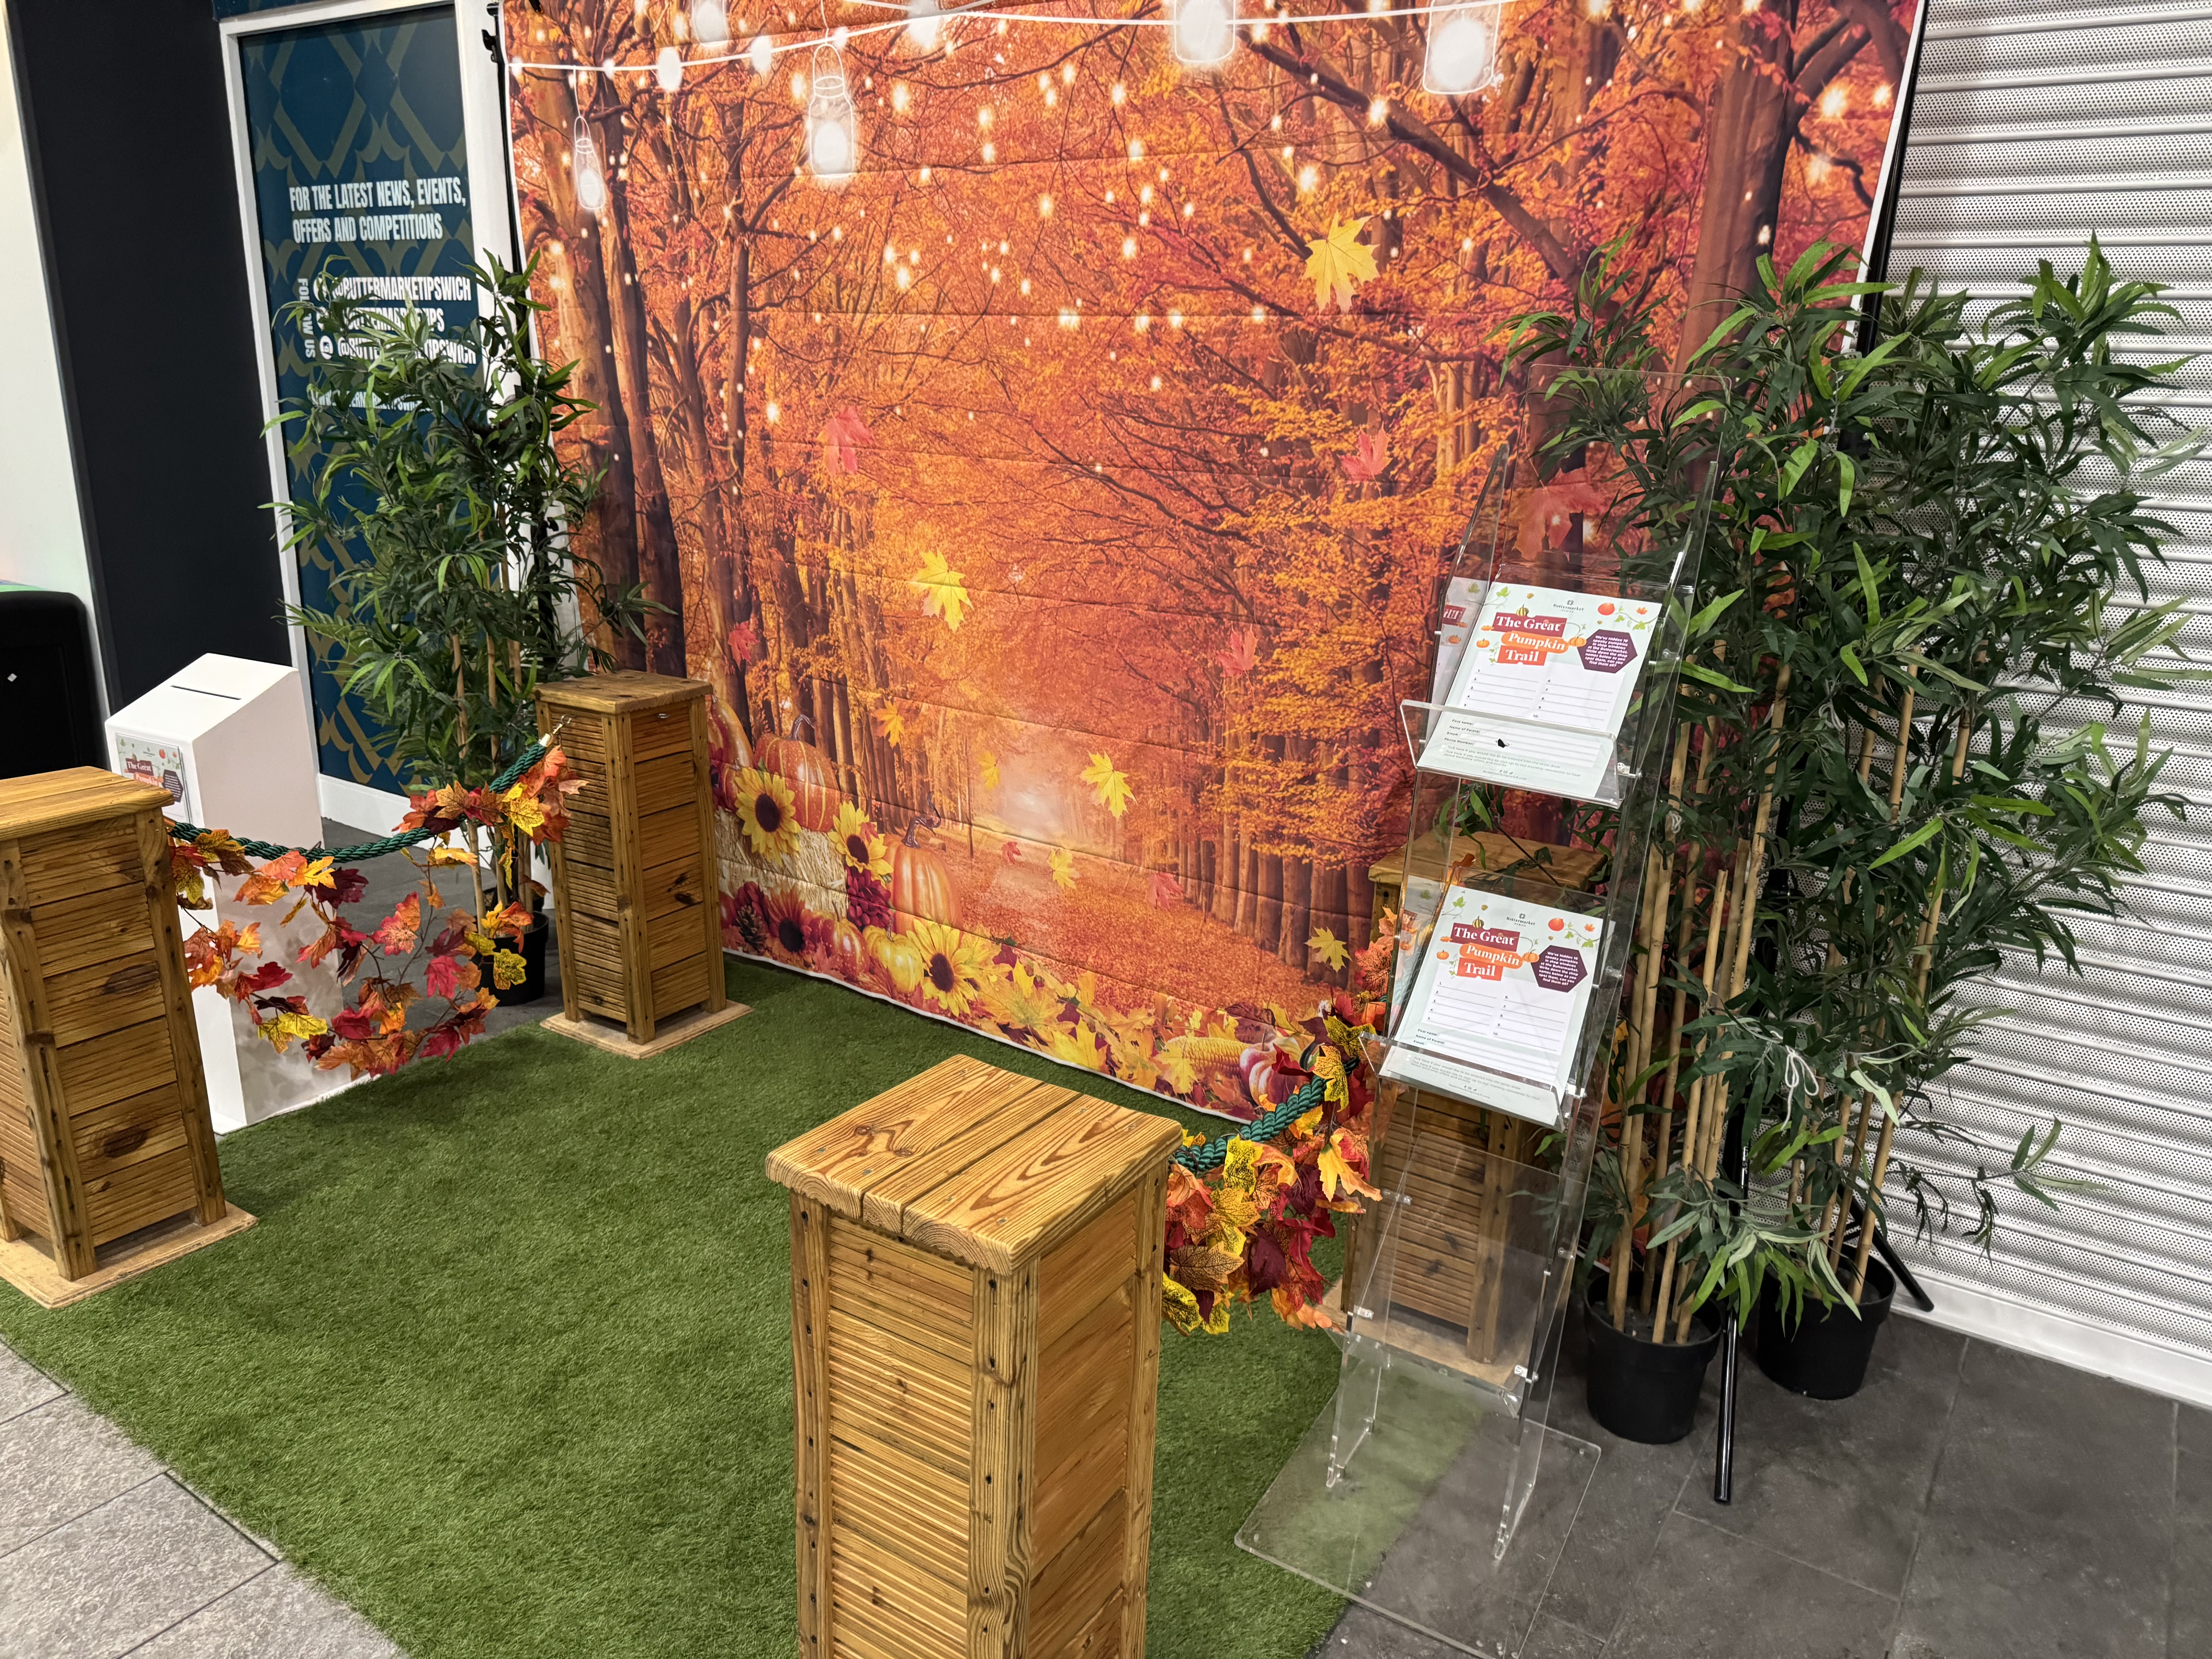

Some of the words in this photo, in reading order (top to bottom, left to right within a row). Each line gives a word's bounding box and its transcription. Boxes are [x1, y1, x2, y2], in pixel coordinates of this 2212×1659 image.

[289, 187, 310, 211] FOR
[311, 185, 333, 210] THE
[335, 182, 373, 209] LATEST
[376, 180, 414, 208] NEWS,
[416, 177, 466, 206] EVENTS,
[293, 218, 332, 243] OFFERS
[334, 216, 357, 242] AND
[359, 213, 443, 240] COMPETITIONS
[298, 278, 313, 335] FOLW
[304, 339, 316, 358] US
[1496, 616, 1521, 628] The
[1523, 618, 1561, 631] Great
[1508, 632, 1565, 650] Pumpkin
[1506, 649, 1539, 661] Trail
[127, 761, 137, 769] The
[137, 763, 152, 772] Great
[136, 773, 158, 786] Pumpkin
[1455, 927, 1477, 939] The
[1480, 931, 1515, 945] Great
[1466, 945, 1519, 966] Pumpkin
[1464, 962, 1496, 976] Trail
